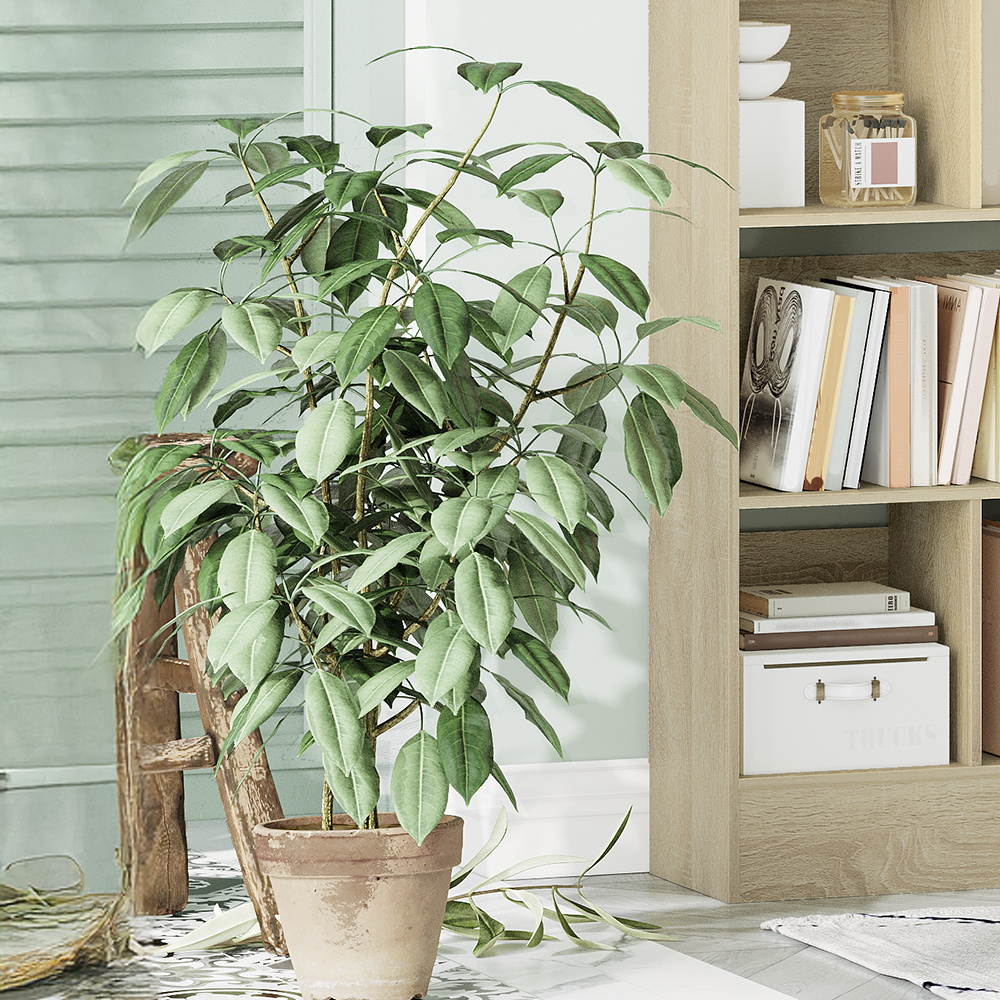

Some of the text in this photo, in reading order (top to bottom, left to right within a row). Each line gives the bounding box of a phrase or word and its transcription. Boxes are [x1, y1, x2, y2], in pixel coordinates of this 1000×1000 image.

[854, 142, 862, 160] MATCH
[854, 167, 862, 186] STRIKE
[844, 723, 937, 750] TRUCKS
